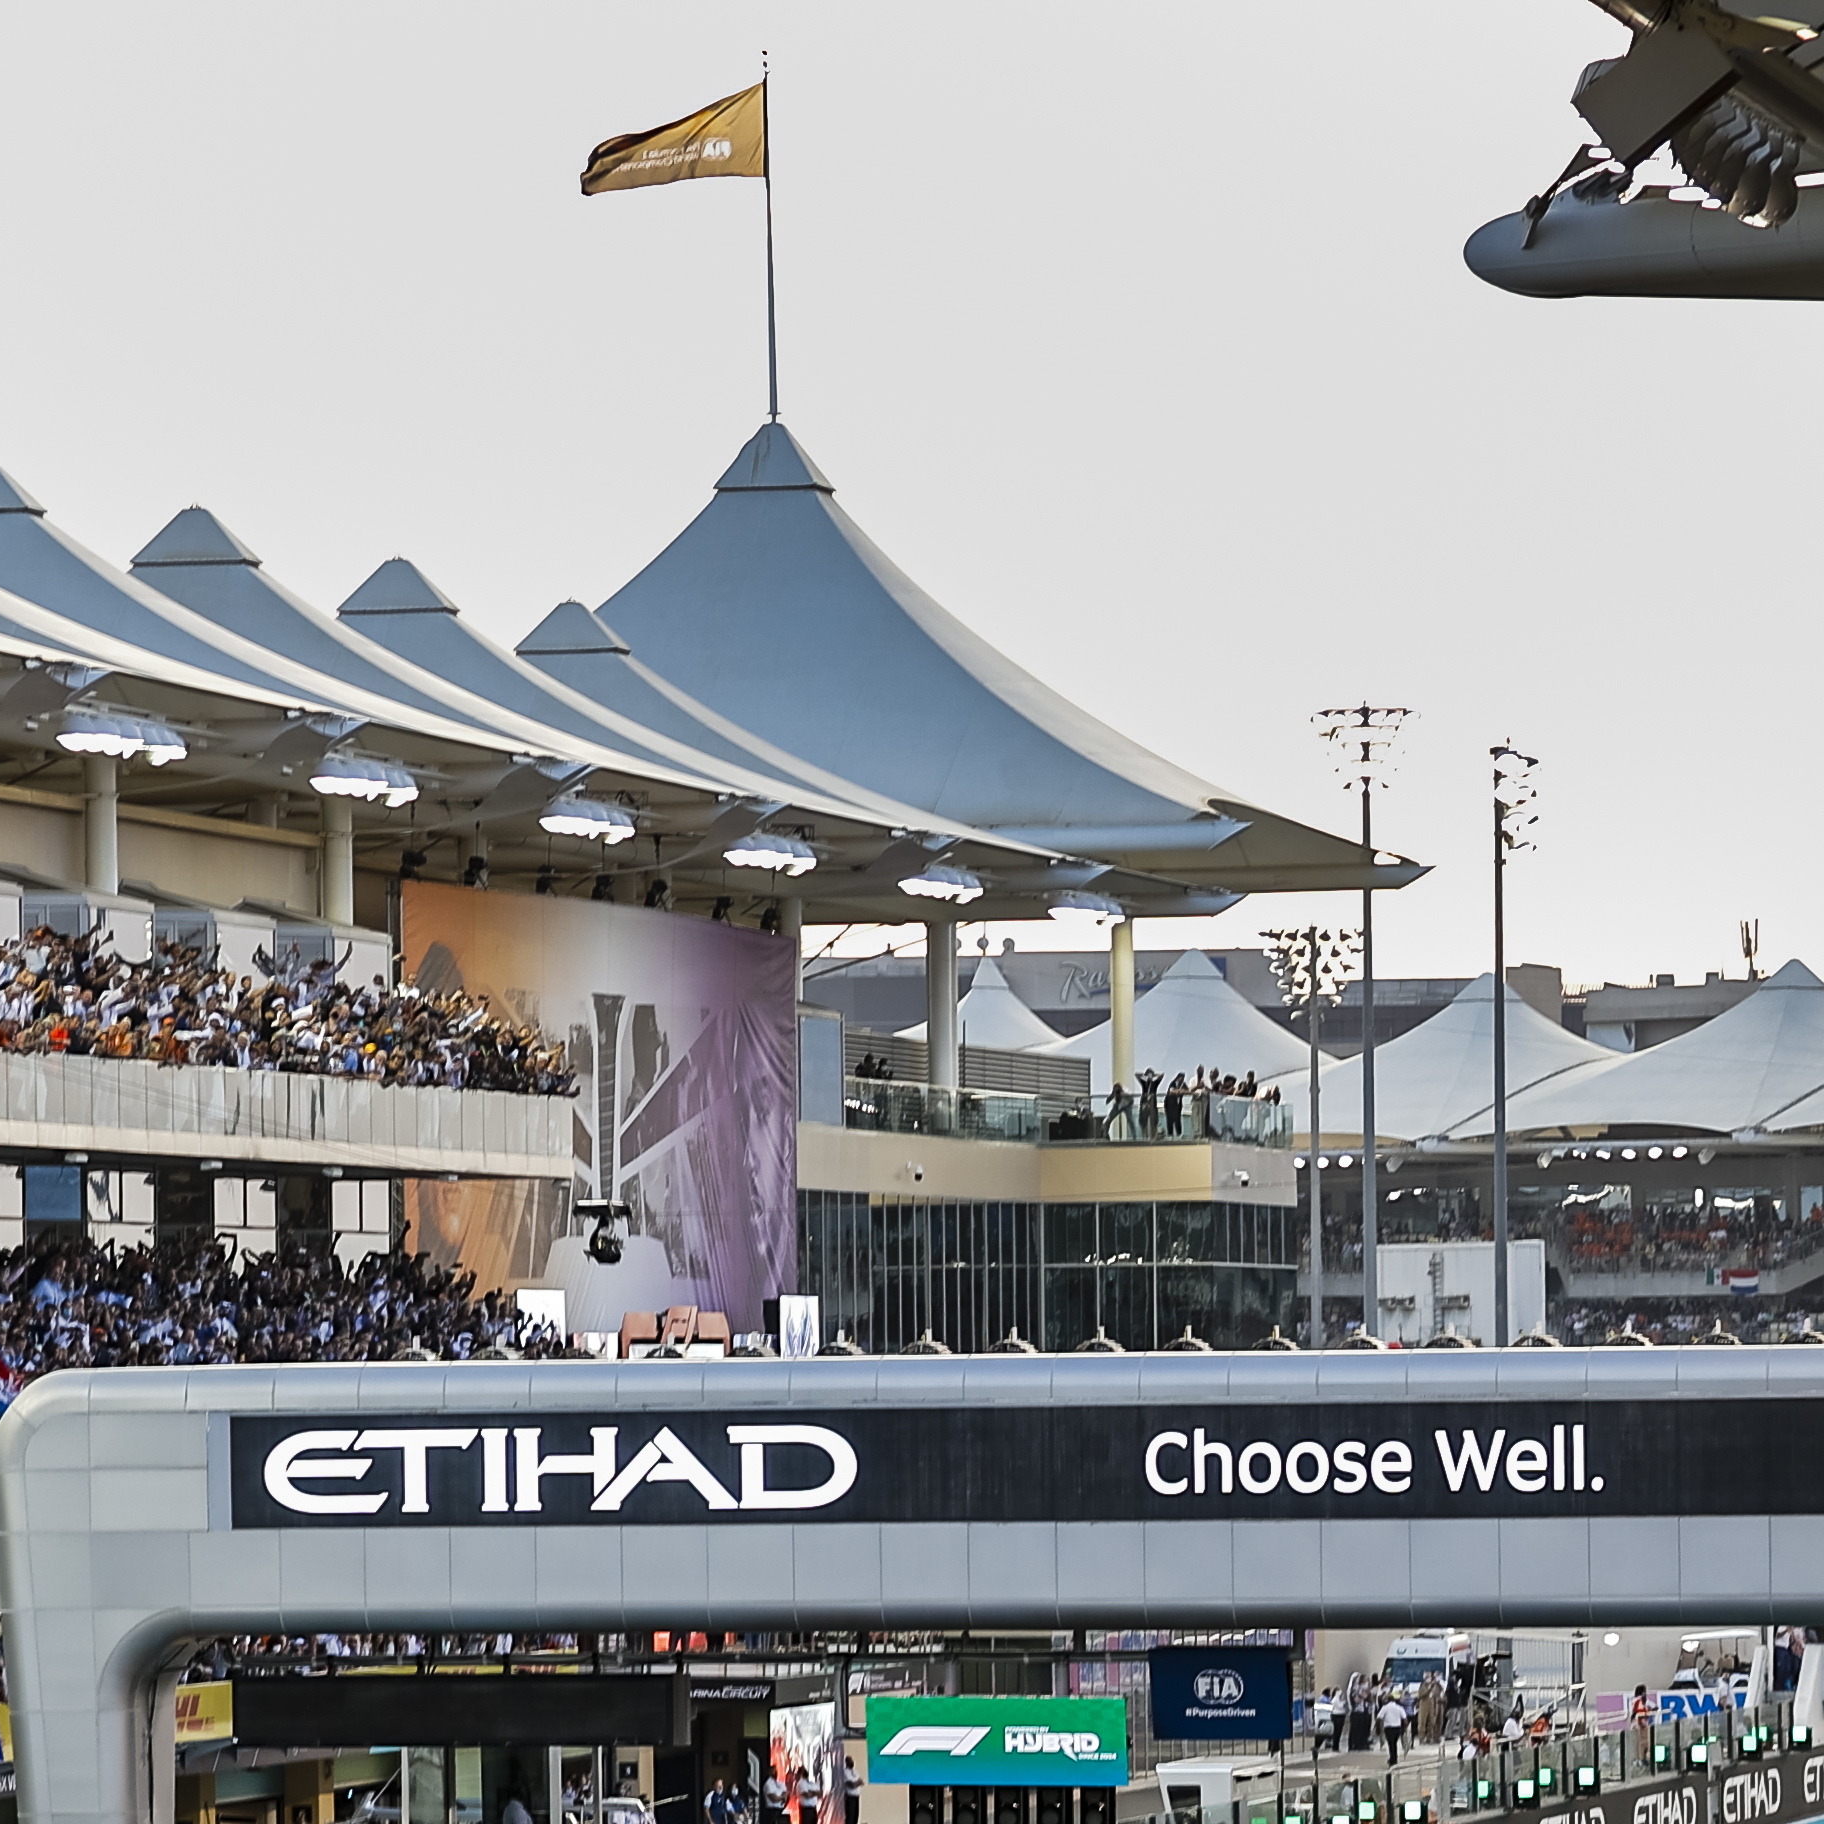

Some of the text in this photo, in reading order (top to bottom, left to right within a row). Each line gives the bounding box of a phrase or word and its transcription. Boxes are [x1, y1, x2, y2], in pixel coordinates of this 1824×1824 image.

[263, 1425, 1606, 1514] ETIHAD Choose Well.
[1197, 1676, 1239, 1699] FIA
[1185, 1706, 1256, 1720] #PurposeDriven
[879, 1725, 992, 1756] F1
[1004, 1732, 1100, 1762] HYBRID
[1723, 1767, 1781, 1824] ETIHAD
